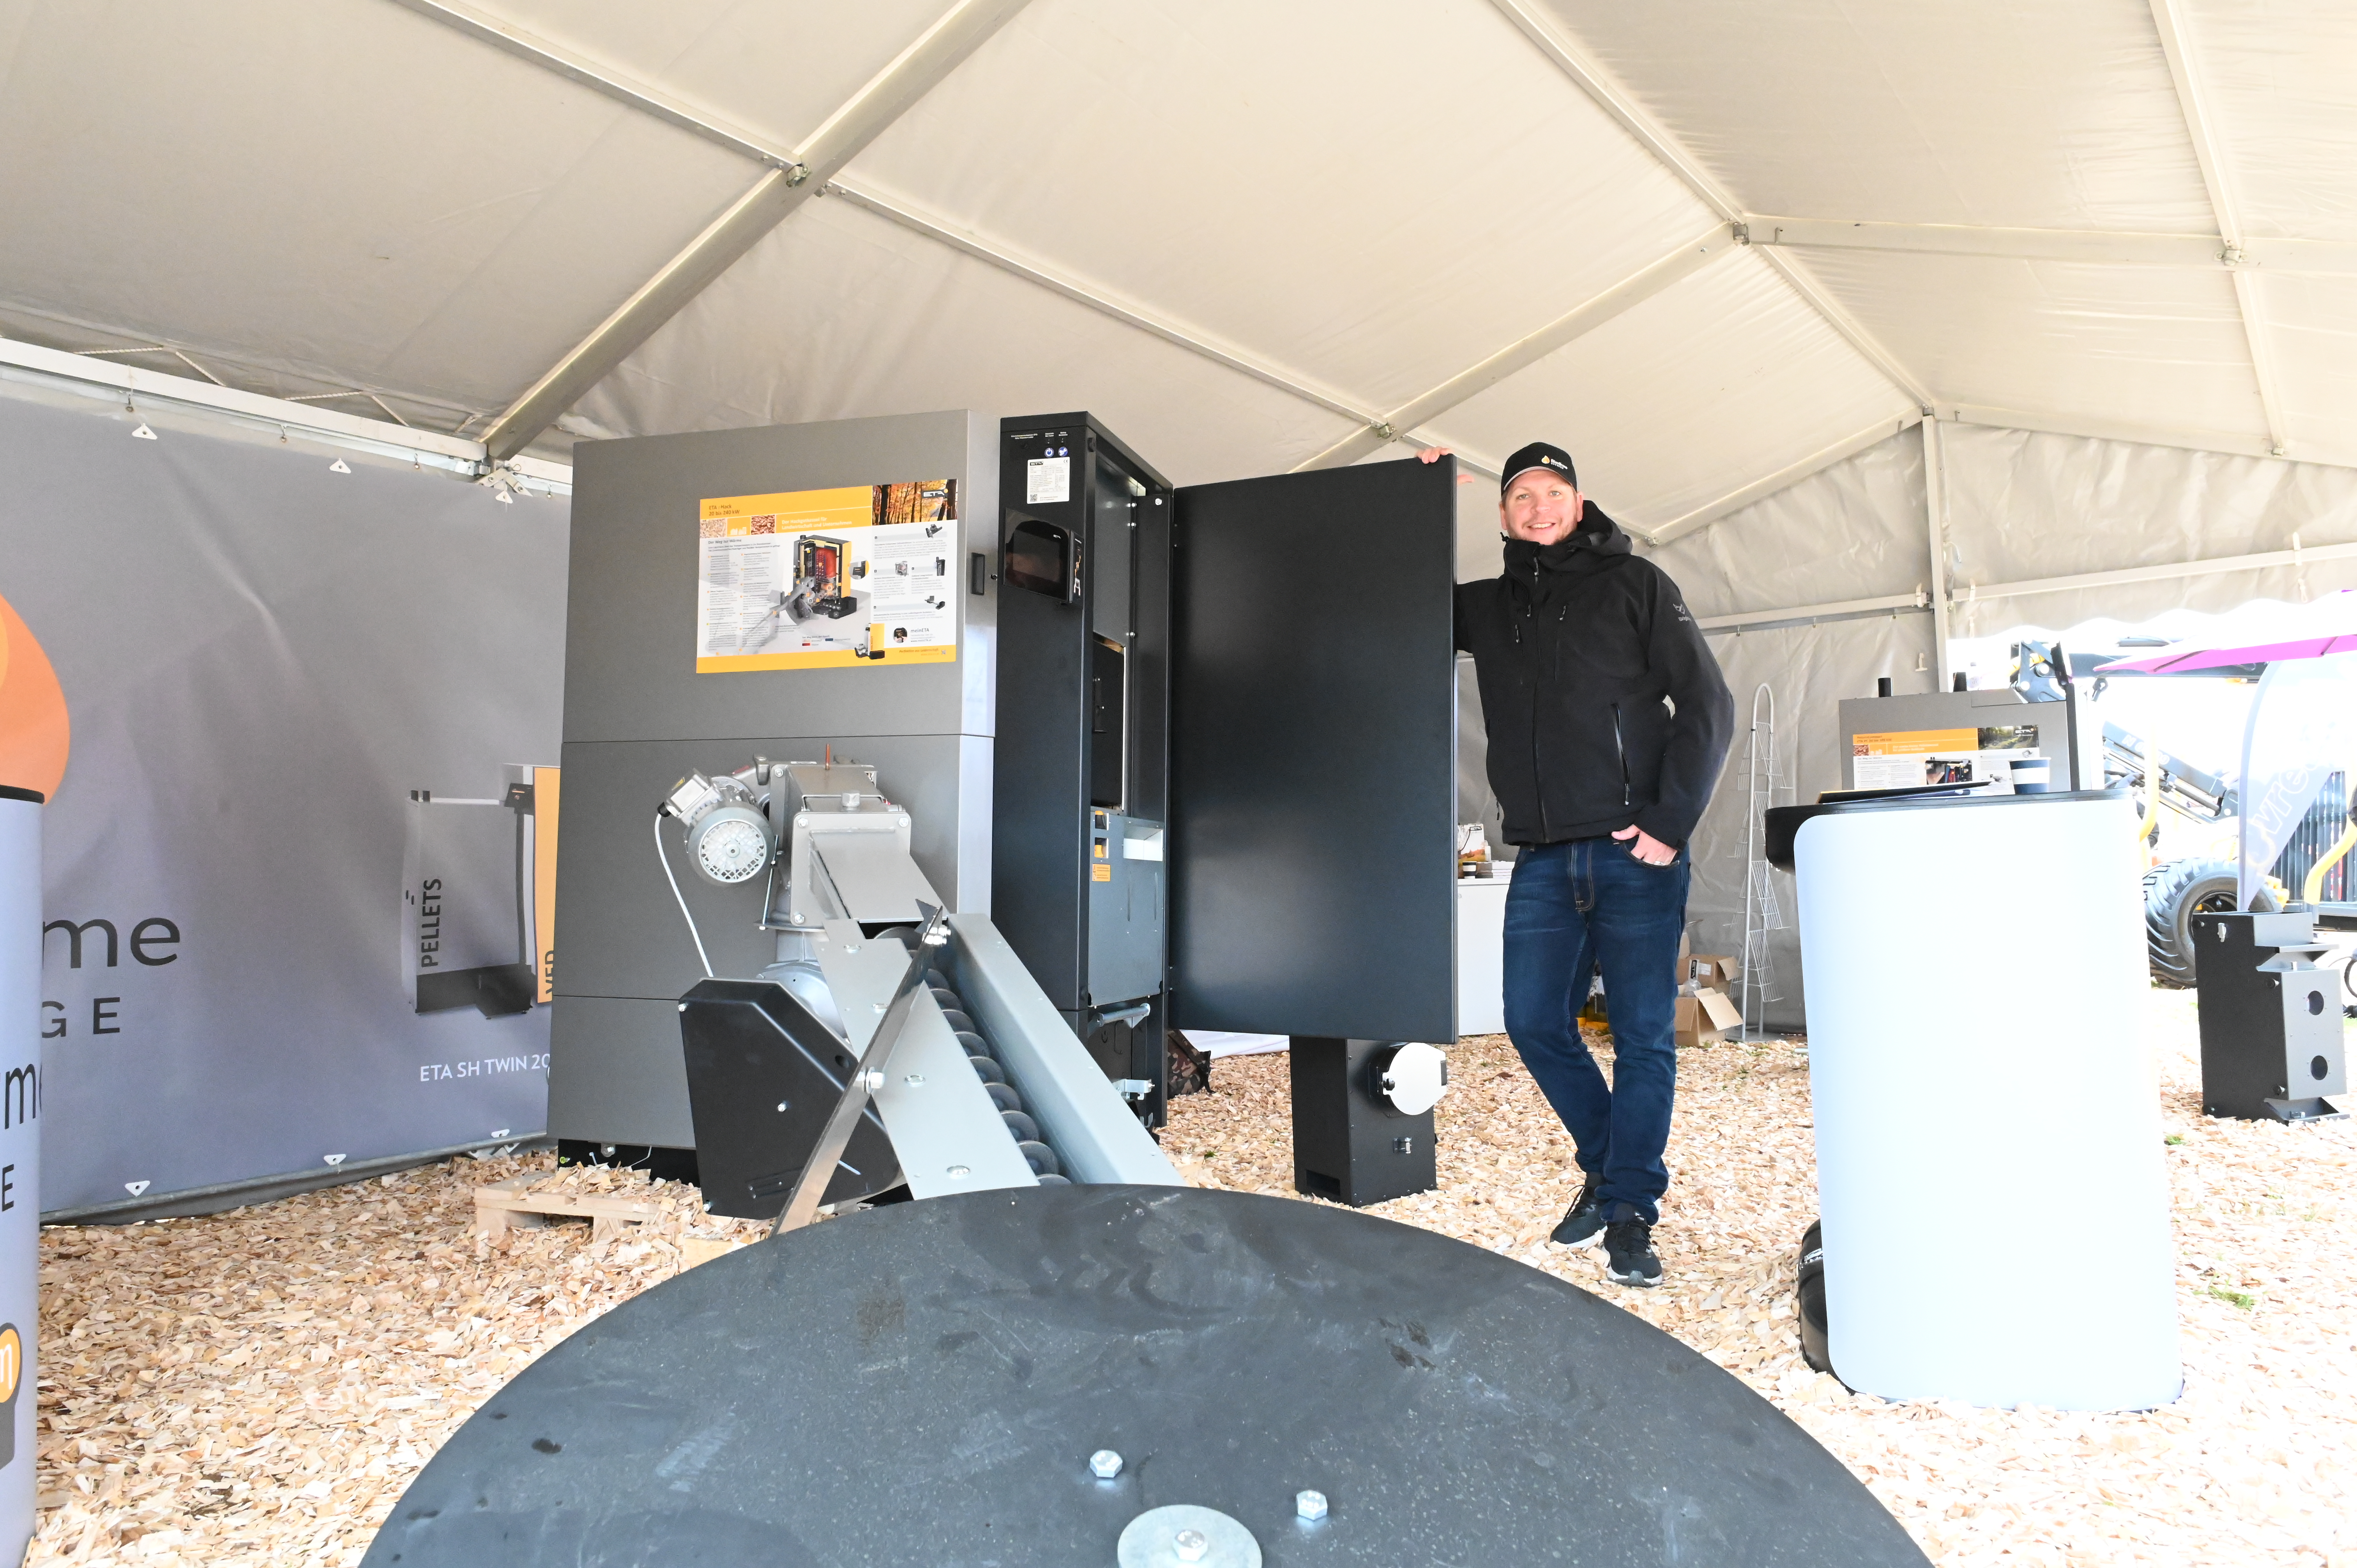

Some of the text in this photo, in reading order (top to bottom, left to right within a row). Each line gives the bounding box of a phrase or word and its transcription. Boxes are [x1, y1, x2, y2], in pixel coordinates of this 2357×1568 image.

[421, 878, 442, 968] PELLETS
[420, 1064, 453, 1082] ETA
[457, 1060, 480, 1078] SH
[484, 1056, 527, 1074] TWIN
